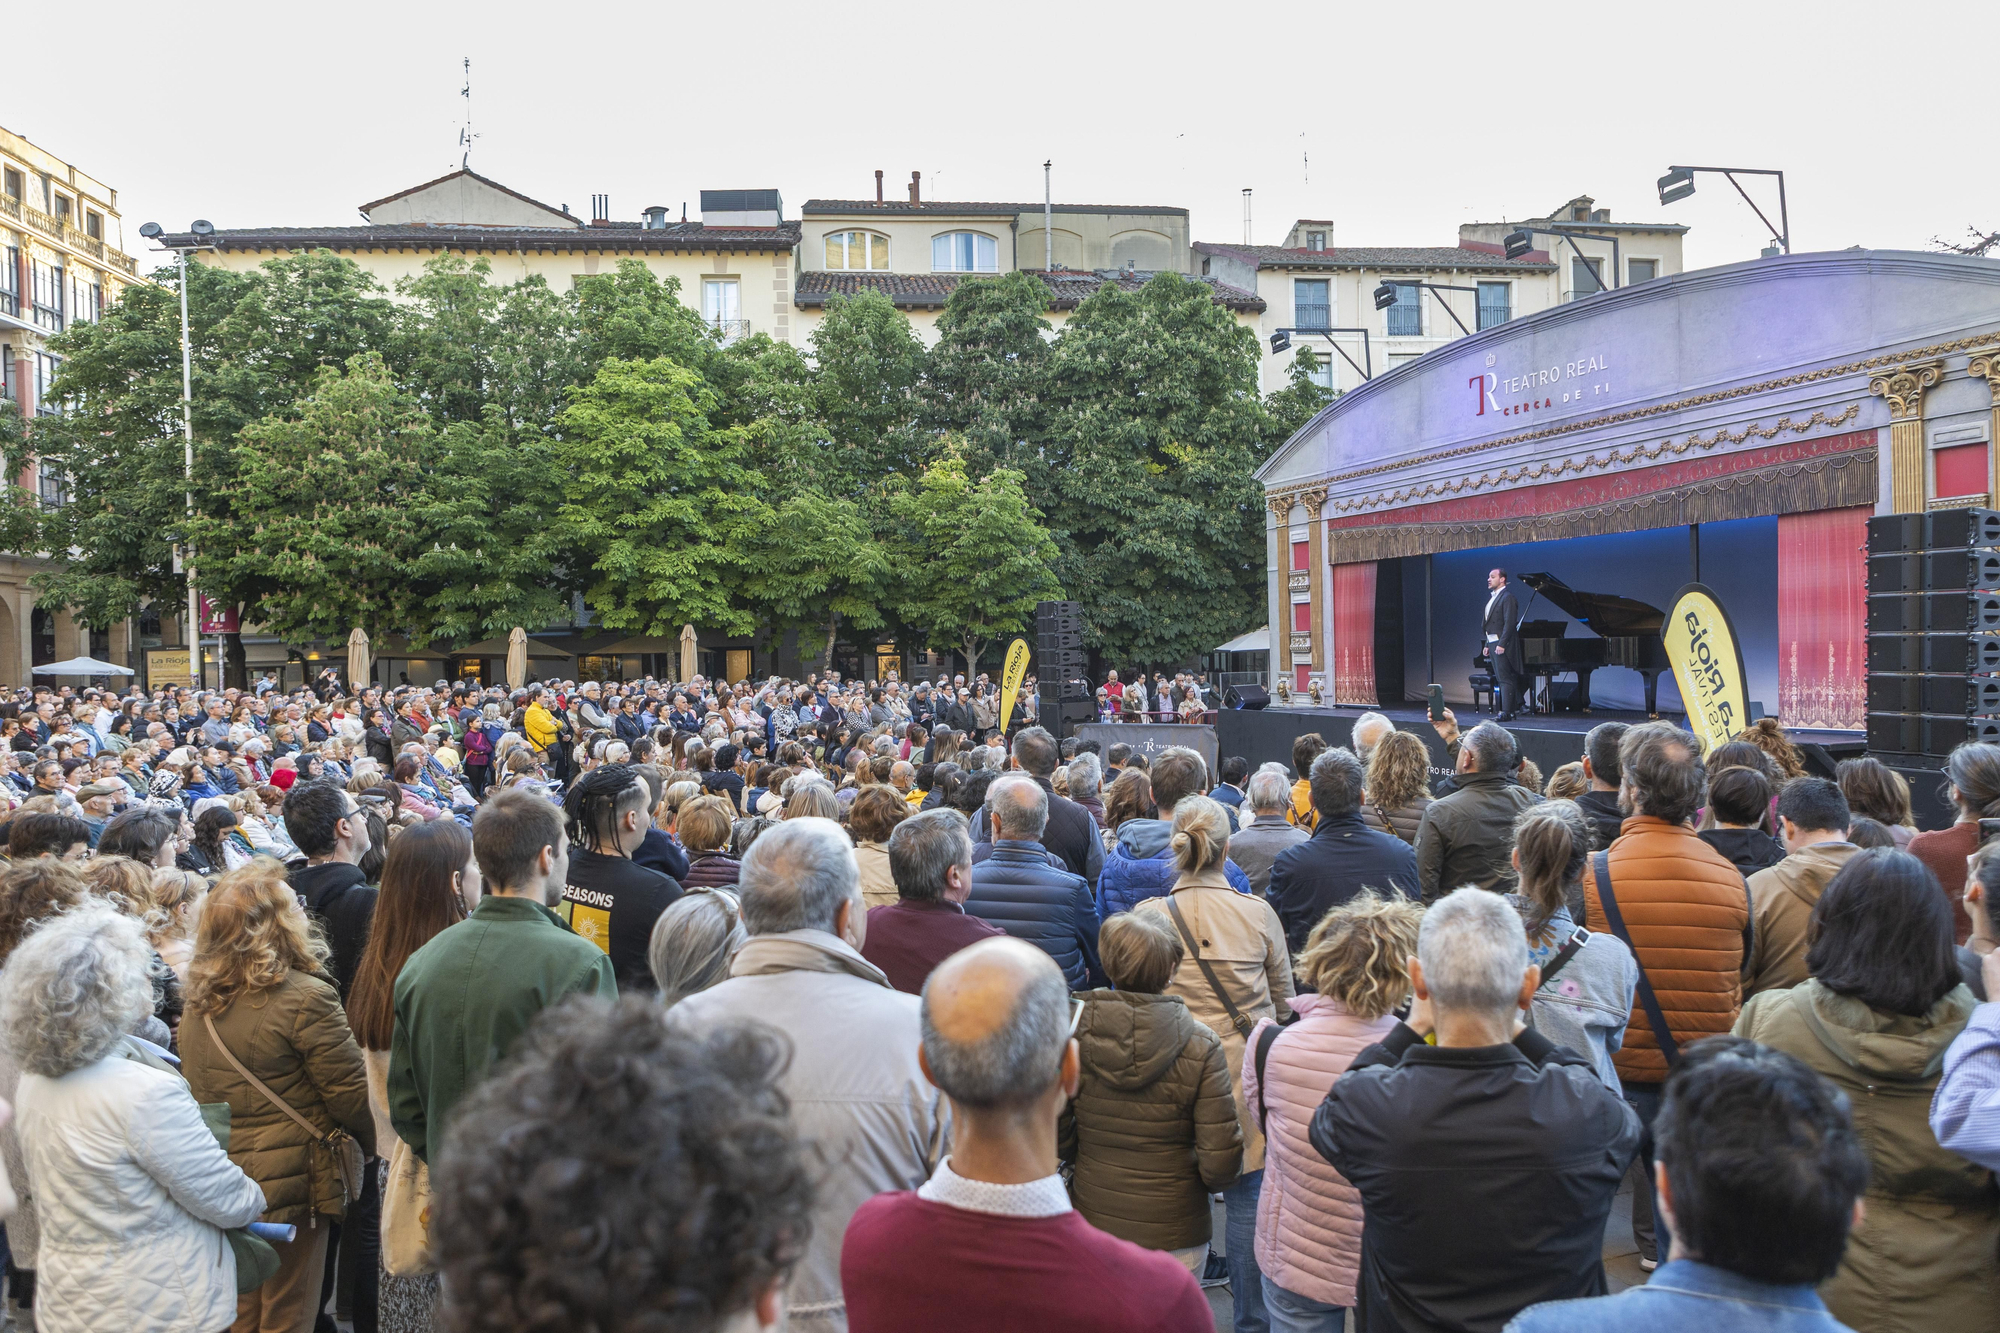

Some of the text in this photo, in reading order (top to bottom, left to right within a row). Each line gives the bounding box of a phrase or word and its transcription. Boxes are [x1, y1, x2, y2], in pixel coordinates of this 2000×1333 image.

[1503, 354, 1608, 395] TEATRO REAL
[1503, 382, 1609, 416] CERCA DE TI
[165, 656, 190, 665] Rioja
[1003, 675, 1012, 690] La
[1009, 645, 1024, 674] Rioja
[561, 883, 615, 908] SEASONS
